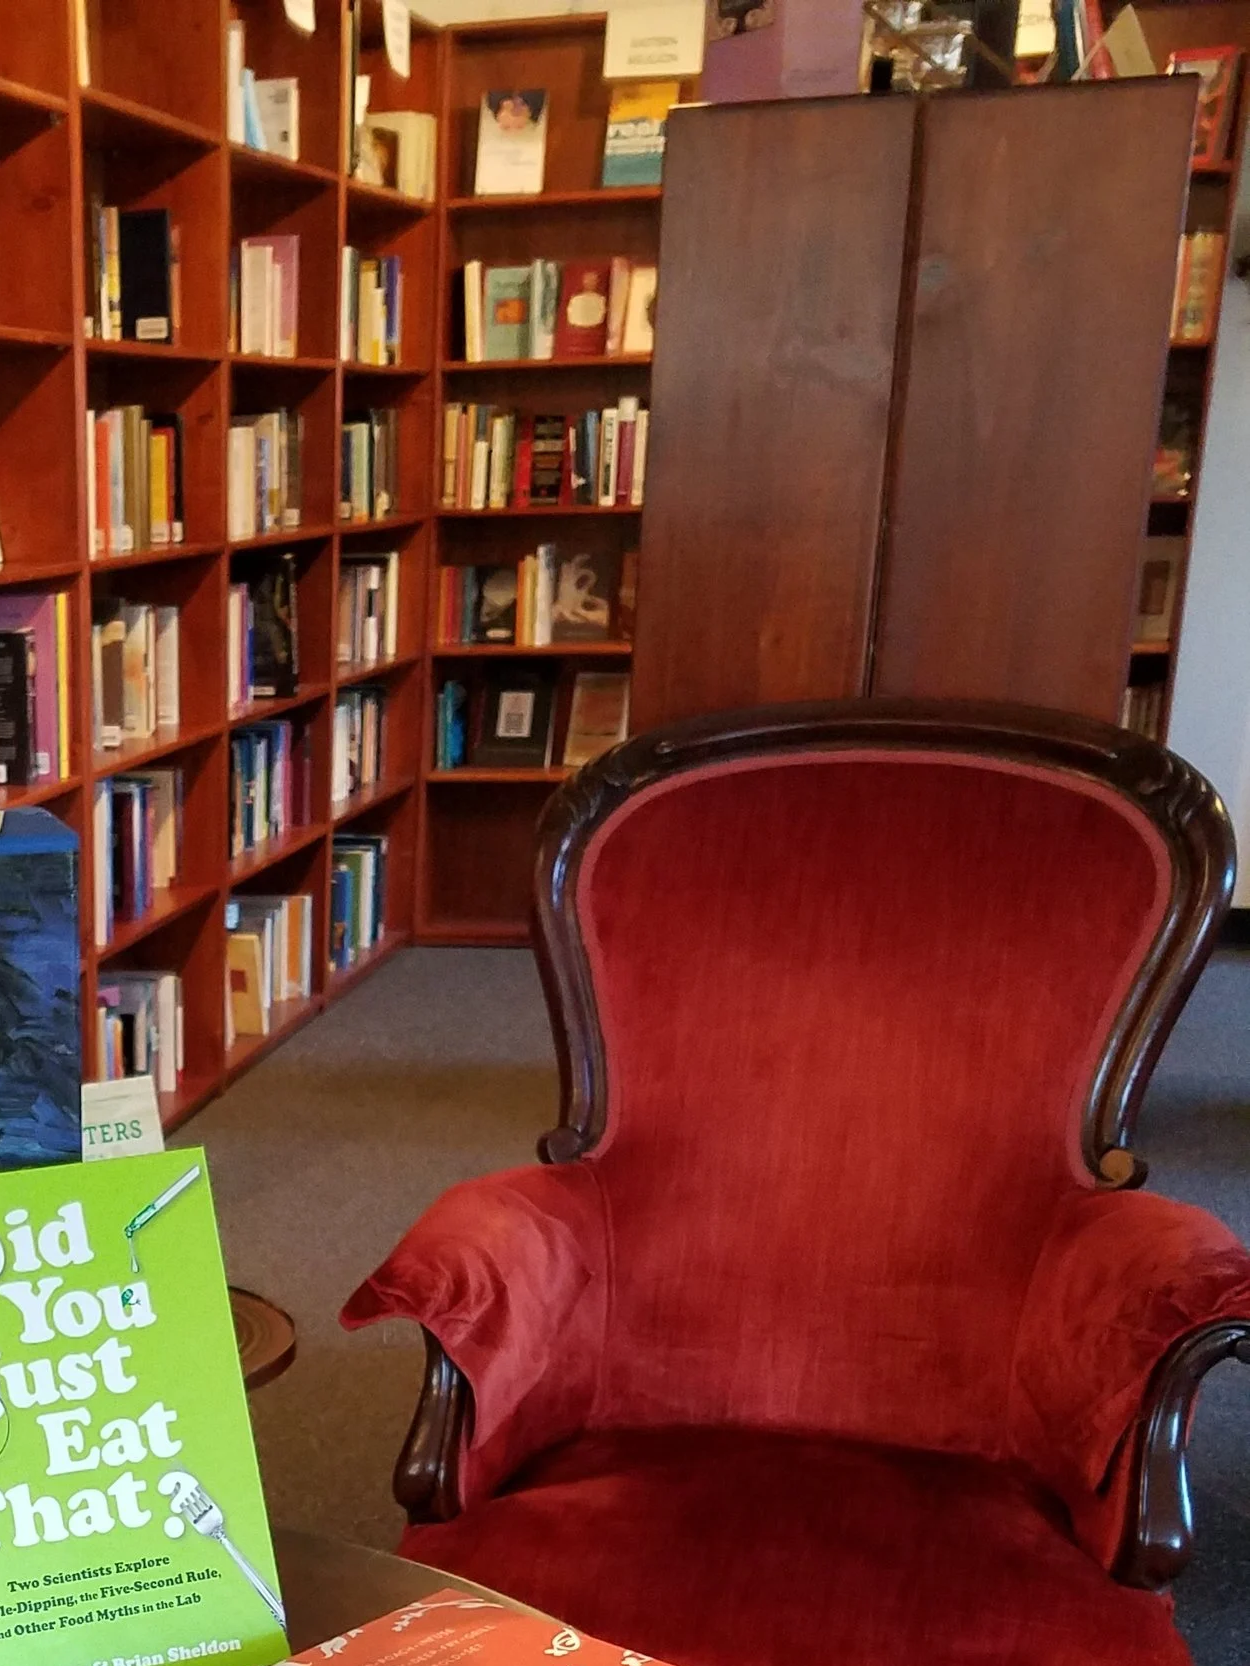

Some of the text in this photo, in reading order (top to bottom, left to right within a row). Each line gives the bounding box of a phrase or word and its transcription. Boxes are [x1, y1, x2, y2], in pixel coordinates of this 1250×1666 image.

[82, 1119, 143, 1146] TERS
[36, 1401, 183, 1476] Eat
[7, 1555, 170, 1593] Two Scientists Explore
[79, 1591, 99, 1603] the
[100, 1574, 183, 1600] Five-Second
[186, 1567, 223, 1583] Rule,
[14, 1620, 56, 1637] Other
[58, 1611, 94, 1628] Food
[96, 1604, 140, 1624] Myths
[142, 1603, 154, 1613] in
[156, 1599, 175, 1611] the
[176, 1592, 202, 1607] Lab
[167, 1637, 242, 1664] Sheldon
